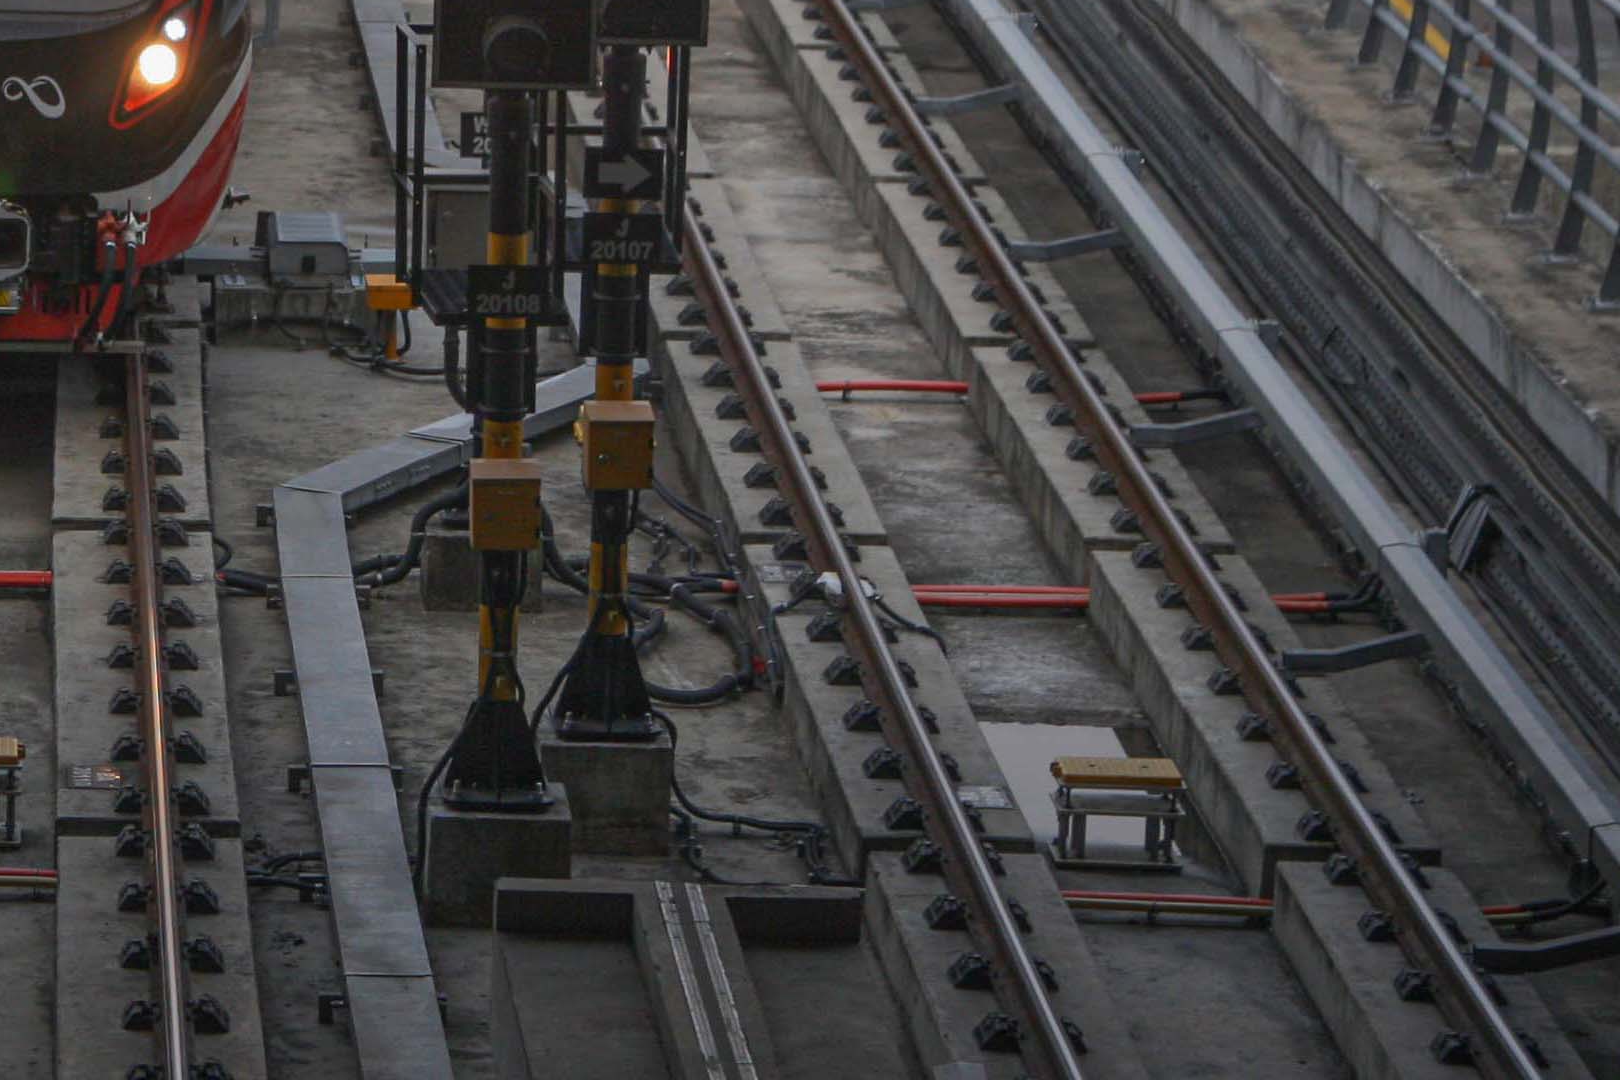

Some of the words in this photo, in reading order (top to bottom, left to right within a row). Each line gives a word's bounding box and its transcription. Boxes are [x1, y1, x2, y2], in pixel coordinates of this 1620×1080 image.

[615, 217, 629, 238] J
[591, 240, 652, 260] 20107
[501, 269, 516, 289] J
[476, 294, 540, 313] 20108
